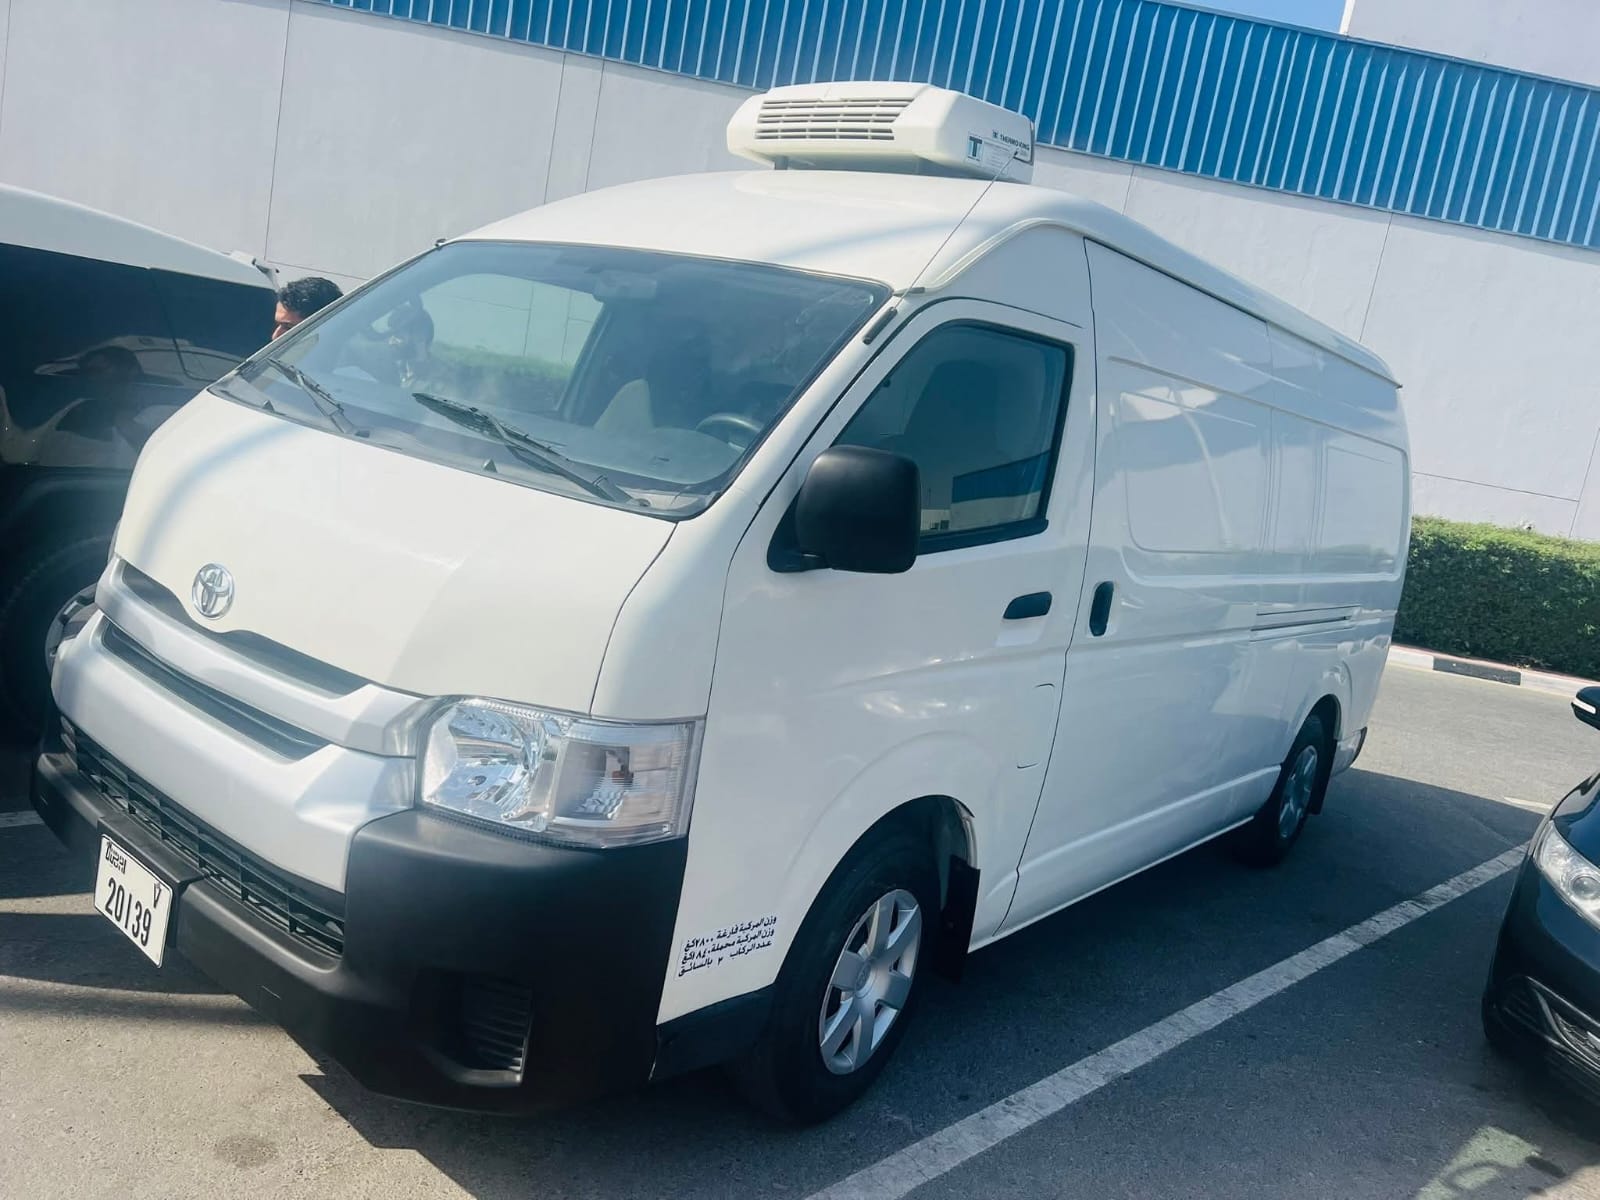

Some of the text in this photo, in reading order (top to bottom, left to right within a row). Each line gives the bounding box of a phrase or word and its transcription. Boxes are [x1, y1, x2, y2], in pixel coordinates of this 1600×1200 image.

[105, 877, 152, 947] 20139
[738, 917, 764, 934] المركبة
[764, 915, 777, 927] وزن
[716, 924, 739, 939] فارغة
[736, 929, 762, 946] المركبة
[761, 927, 775, 939] وزن
[711, 941, 736, 953] محملة
[729, 943, 756, 960] الركاب
[755, 940, 773, 949] عدد
[678, 957, 713, 977] بالسائق
